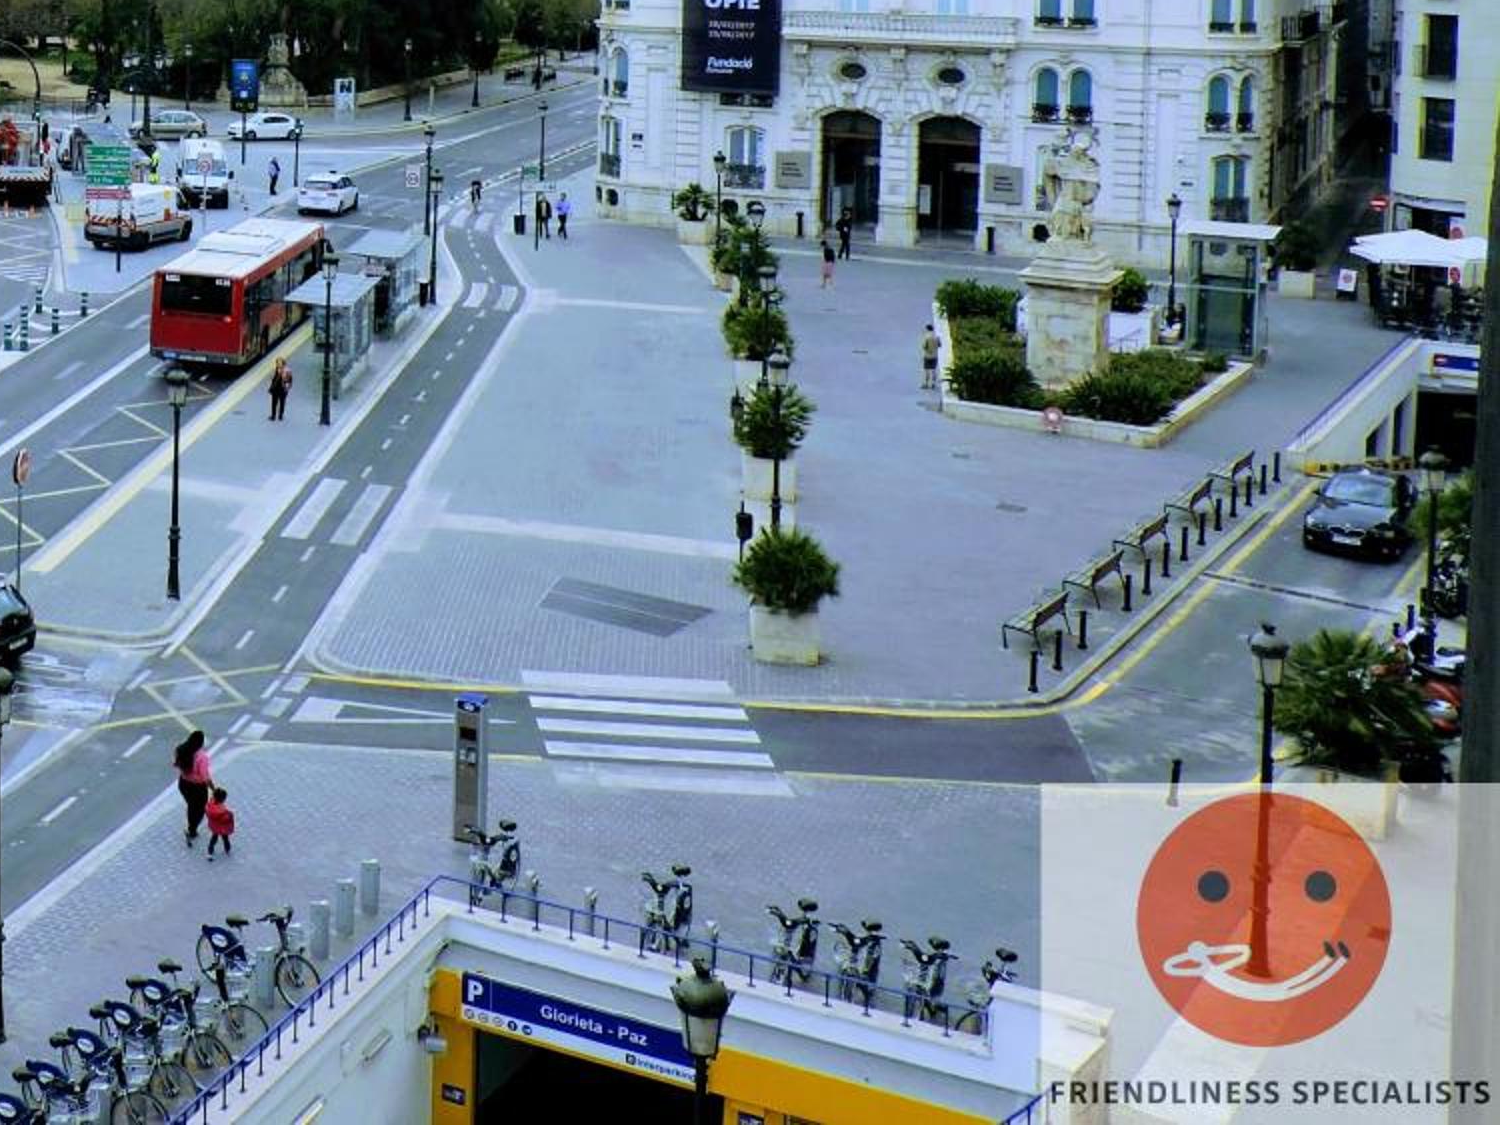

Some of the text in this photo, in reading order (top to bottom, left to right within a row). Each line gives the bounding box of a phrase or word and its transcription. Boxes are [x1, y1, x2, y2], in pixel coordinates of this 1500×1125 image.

[707, 56, 753, 69] Fundació
[467, 978, 483, 1002] P
[540, 1004, 603, 1035] Glorieta
[617, 1026, 648, 1047] Paz
